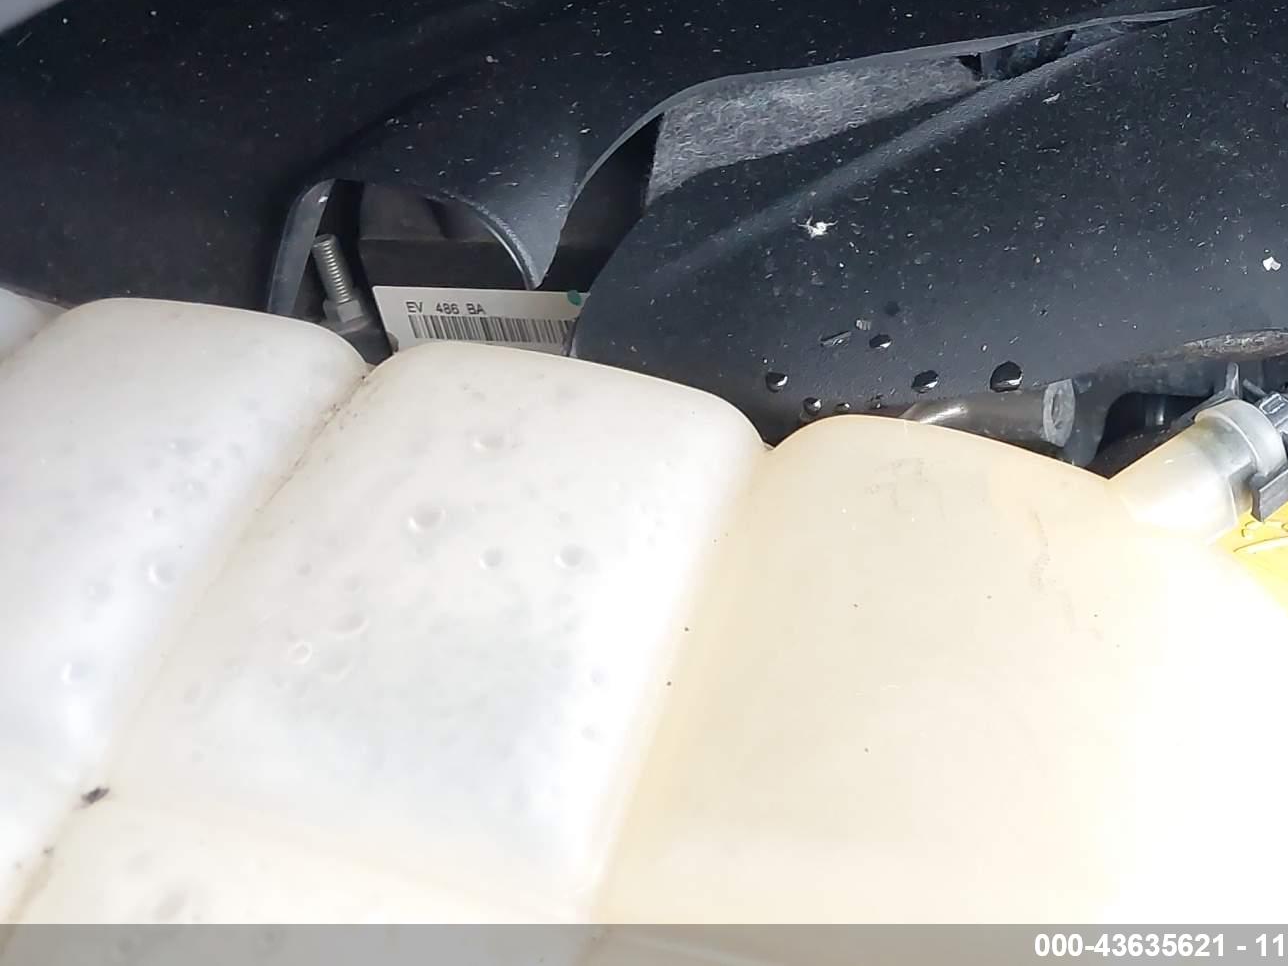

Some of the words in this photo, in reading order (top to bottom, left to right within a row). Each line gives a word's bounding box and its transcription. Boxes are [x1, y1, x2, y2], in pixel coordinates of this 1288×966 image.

[405, 301, 423, 314] EV
[435, 302, 460, 315] 486
[466, 303, 486, 315] BA
